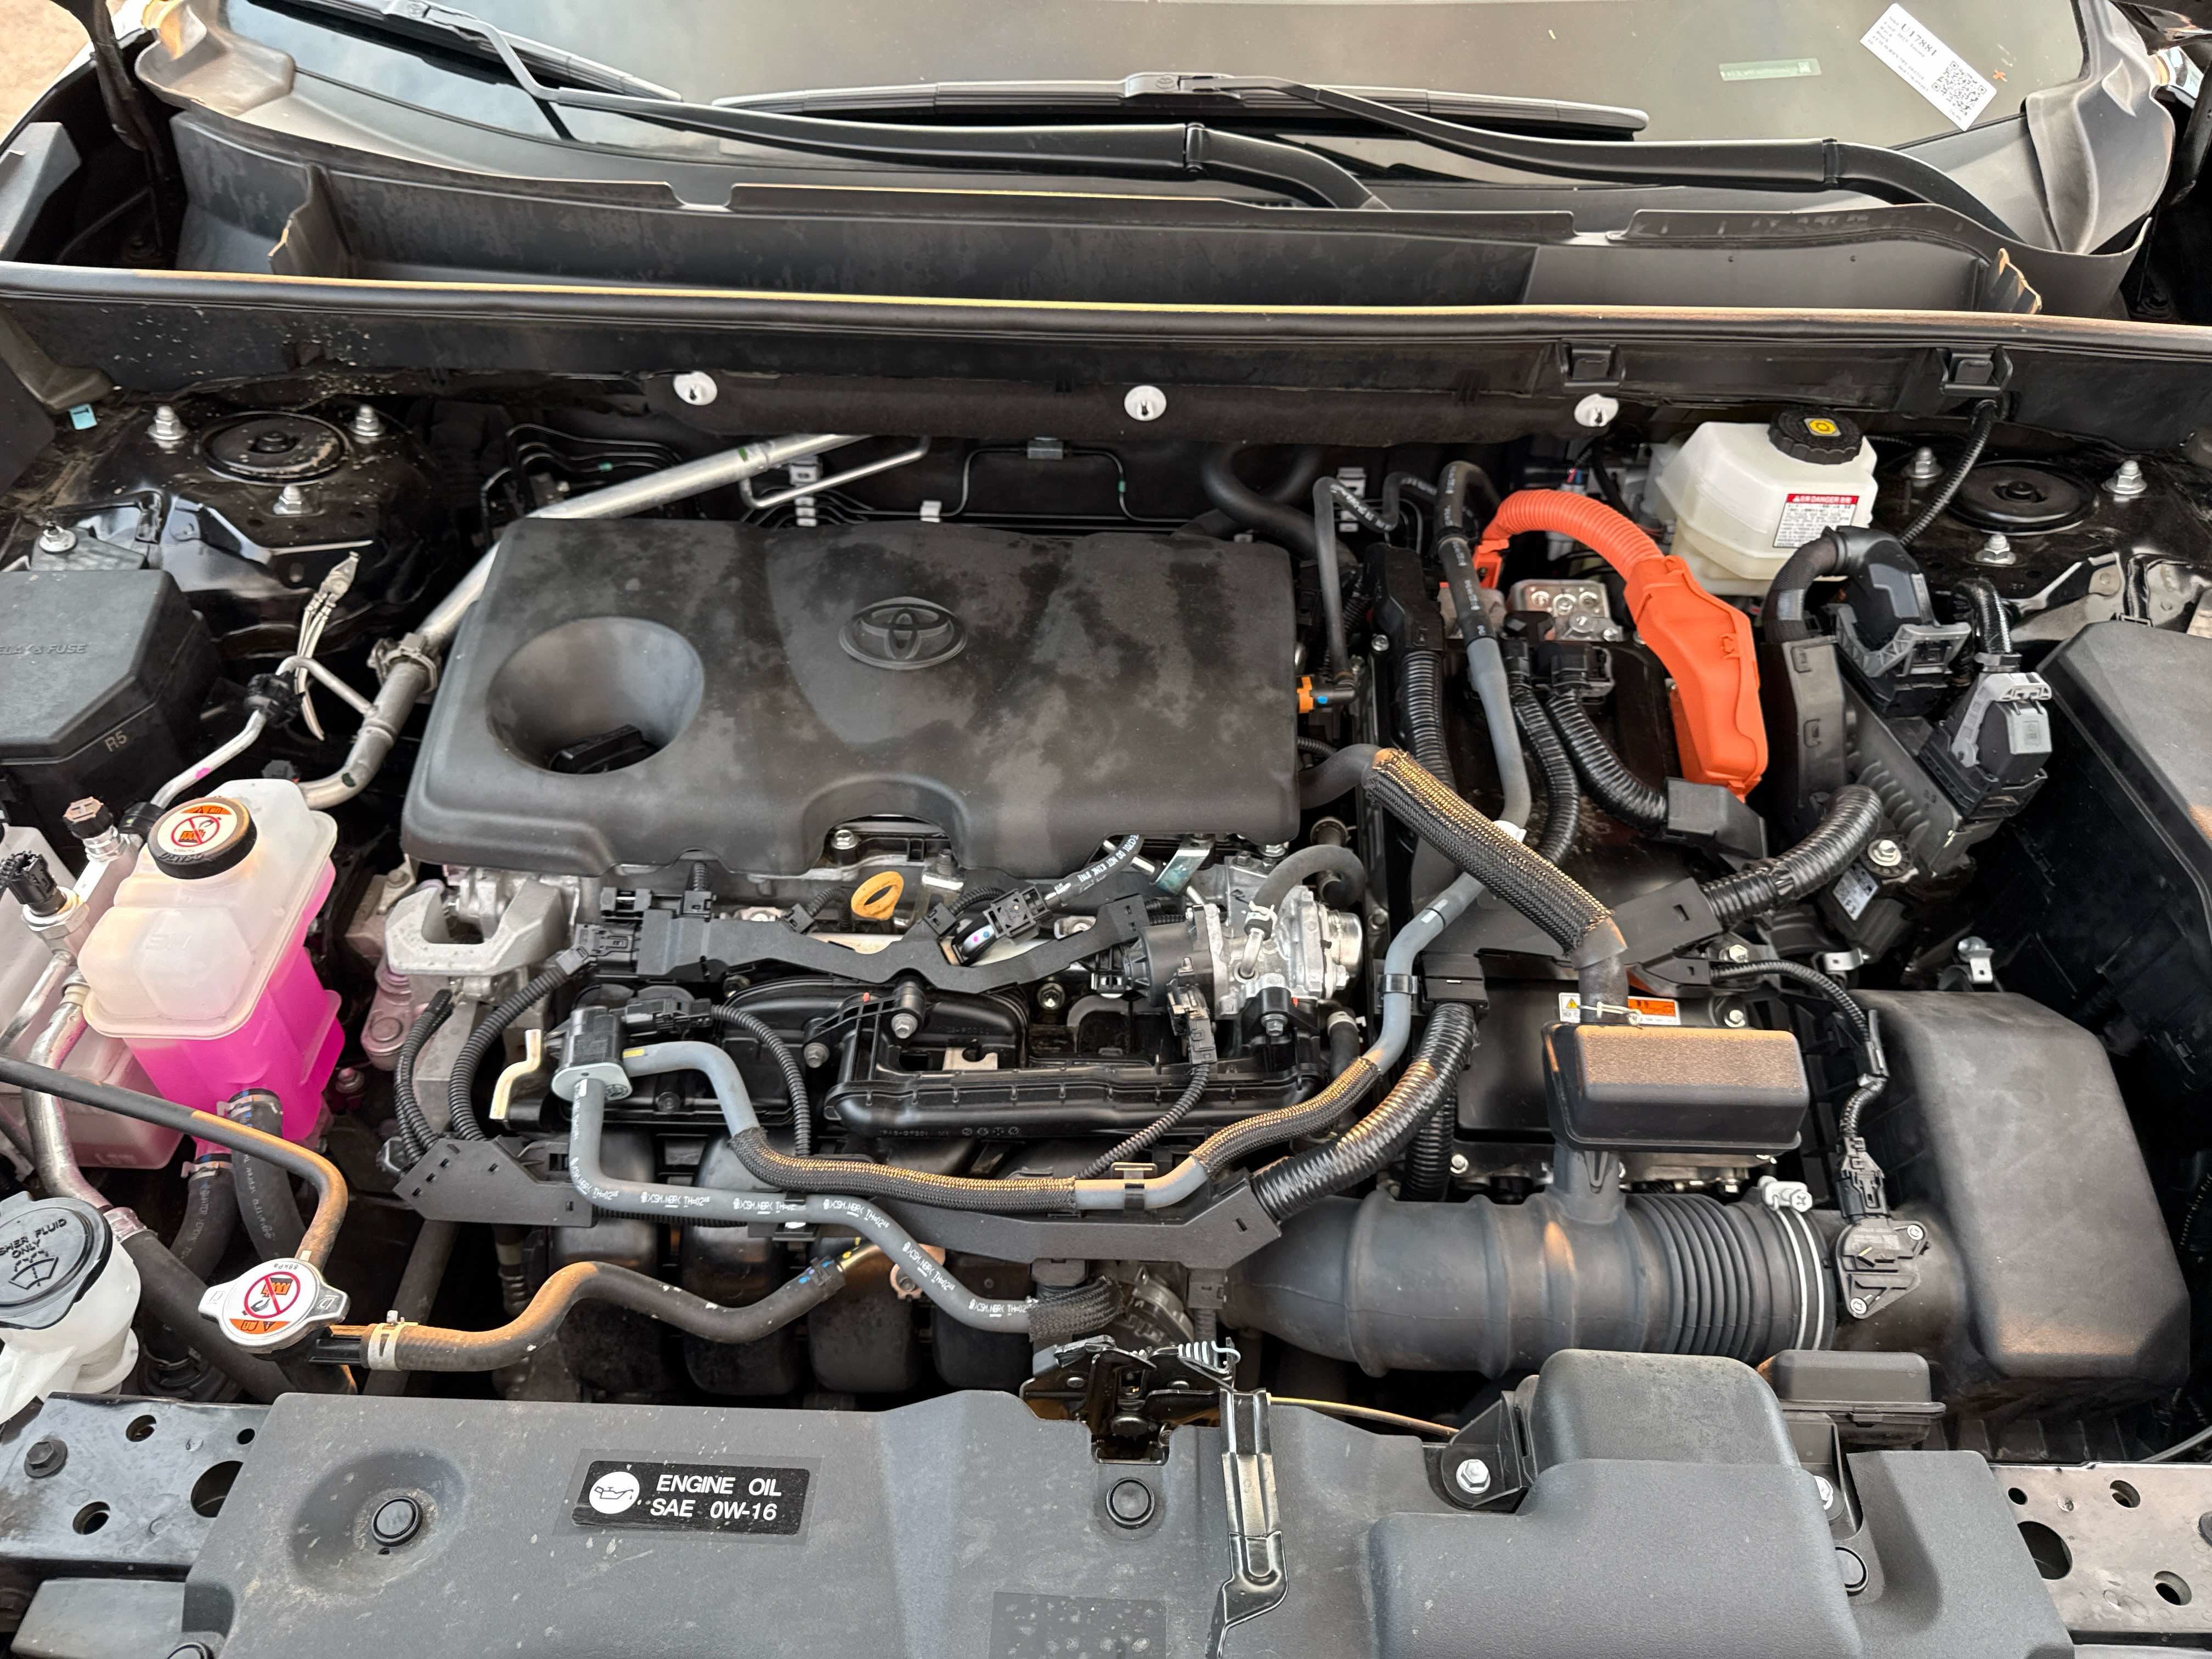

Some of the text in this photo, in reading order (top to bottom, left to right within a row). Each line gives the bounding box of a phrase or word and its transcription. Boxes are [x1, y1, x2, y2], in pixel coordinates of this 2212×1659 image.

[1901, 24, 1937, 57] U17881
[47, 644, 87, 654] FUSE
[104, 730, 128, 753] R5
[35, 1218, 67, 1238] FLUID
[12, 1240, 41, 1259] ONLY
[656, 1474, 782, 1497] ENGINE OIL
[650, 1498, 778, 1521] SAE 0W-16
